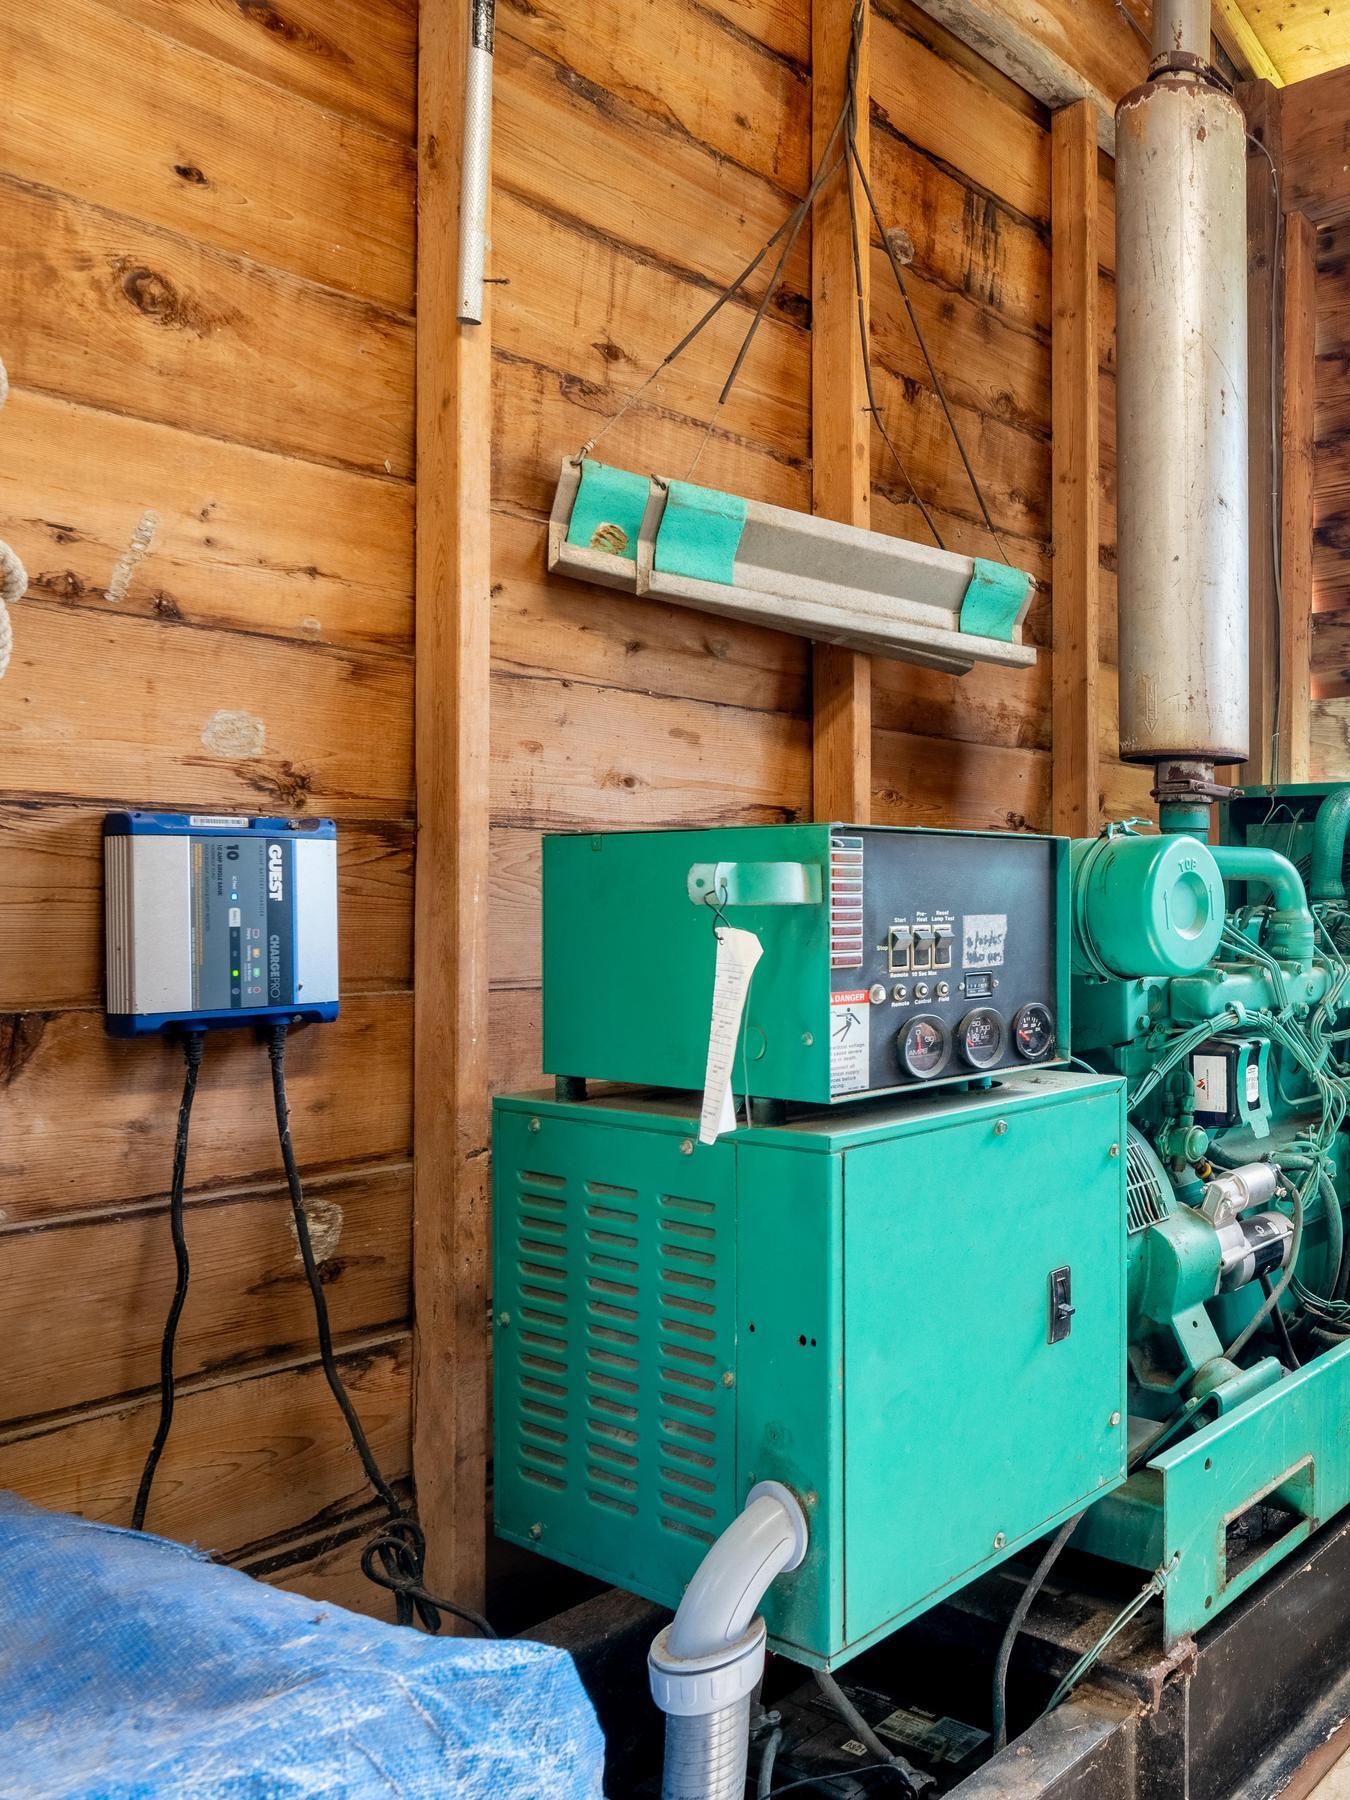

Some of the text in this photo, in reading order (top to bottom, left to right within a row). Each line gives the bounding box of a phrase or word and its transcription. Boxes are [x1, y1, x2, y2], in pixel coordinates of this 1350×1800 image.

[226, 844, 239, 860] 10
[268, 844, 283, 901] GUEST
[1177, 856, 1197, 873] TOP
[269, 934, 281, 999] CHARGEPRO
[834, 993, 865, 1003] DANGER
